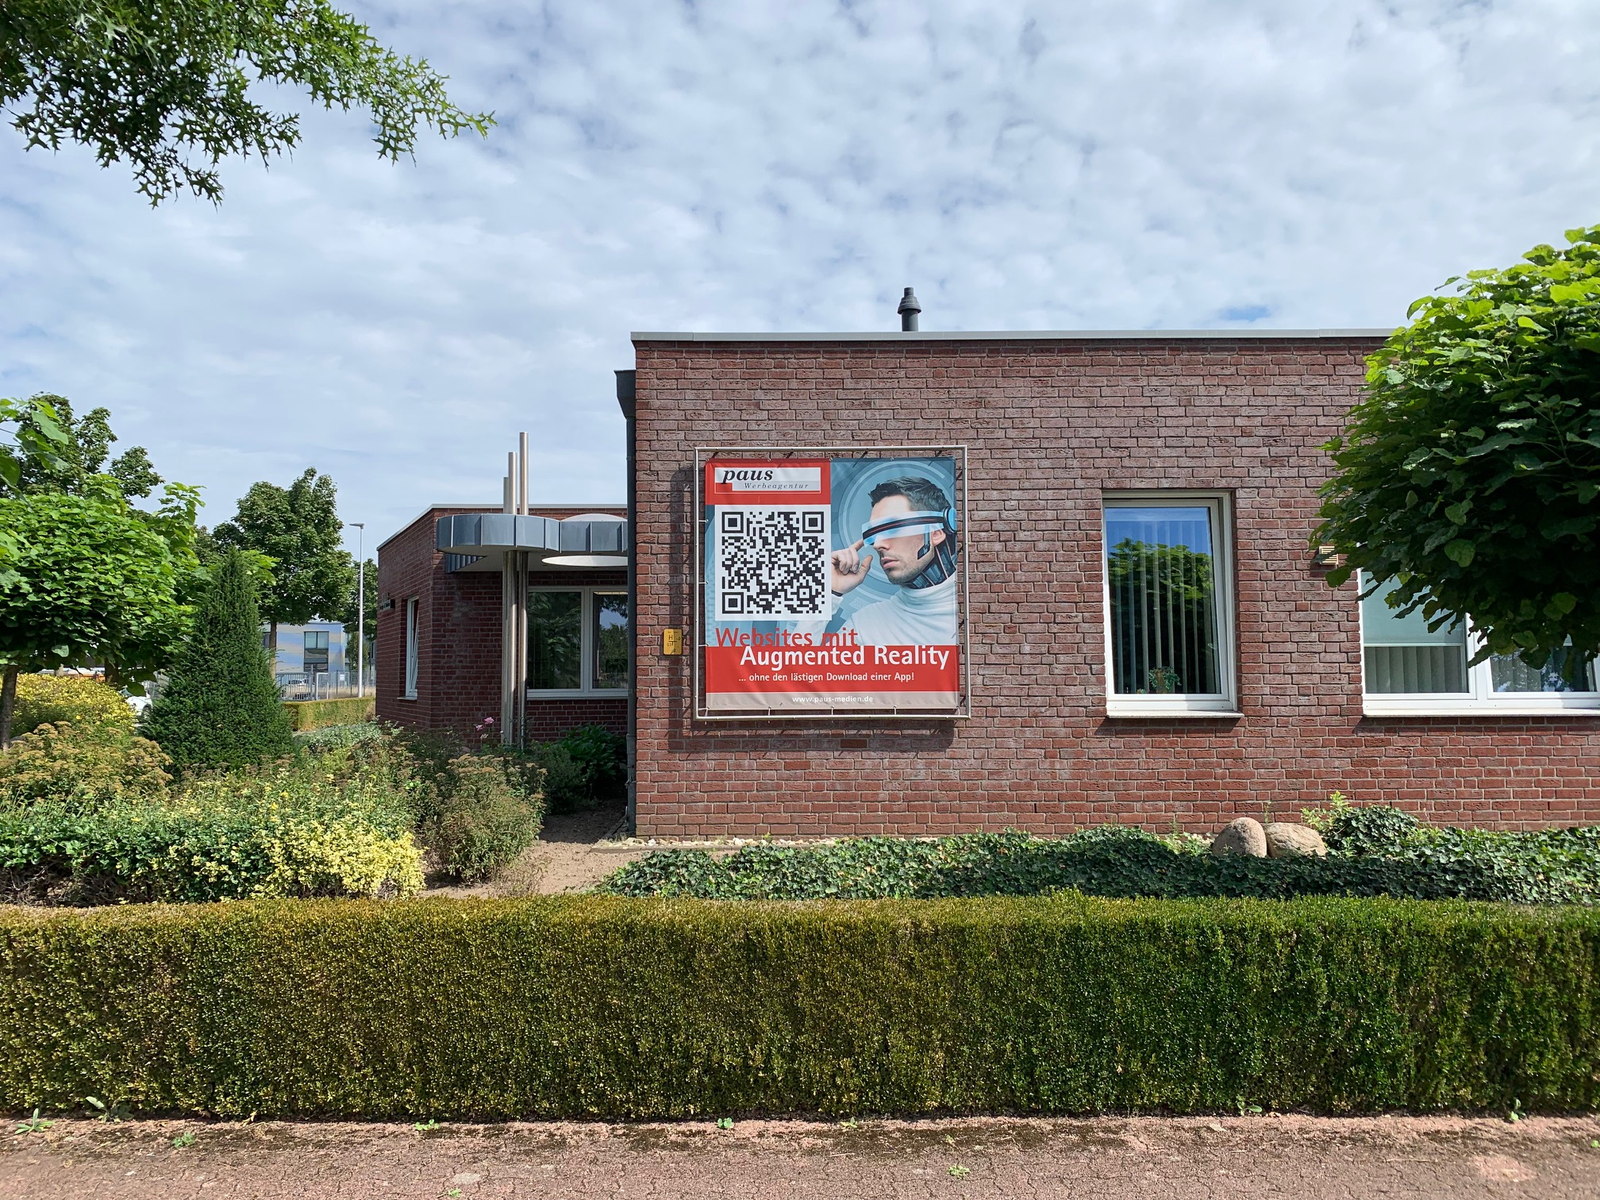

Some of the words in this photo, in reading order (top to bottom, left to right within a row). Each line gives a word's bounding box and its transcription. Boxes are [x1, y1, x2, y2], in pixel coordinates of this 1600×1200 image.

[721, 469, 774, 485] paus
[743, 482, 809, 490] Werbeagentur
[715, 627, 813, 647] Websites
[821, 627, 858, 647] mit
[739, 644, 865, 672] Augmented
[874, 643, 950, 671] Reality
[749, 672, 770, 682] ohne
[772, 672, 788, 681] den
[791, 672, 823, 684] lästigen
[826, 672, 868, 681] Download
[870, 672, 892, 681] einer
[894, 672, 915, 683] App!
[791, 695, 874, 704] www.paus-medien.de
